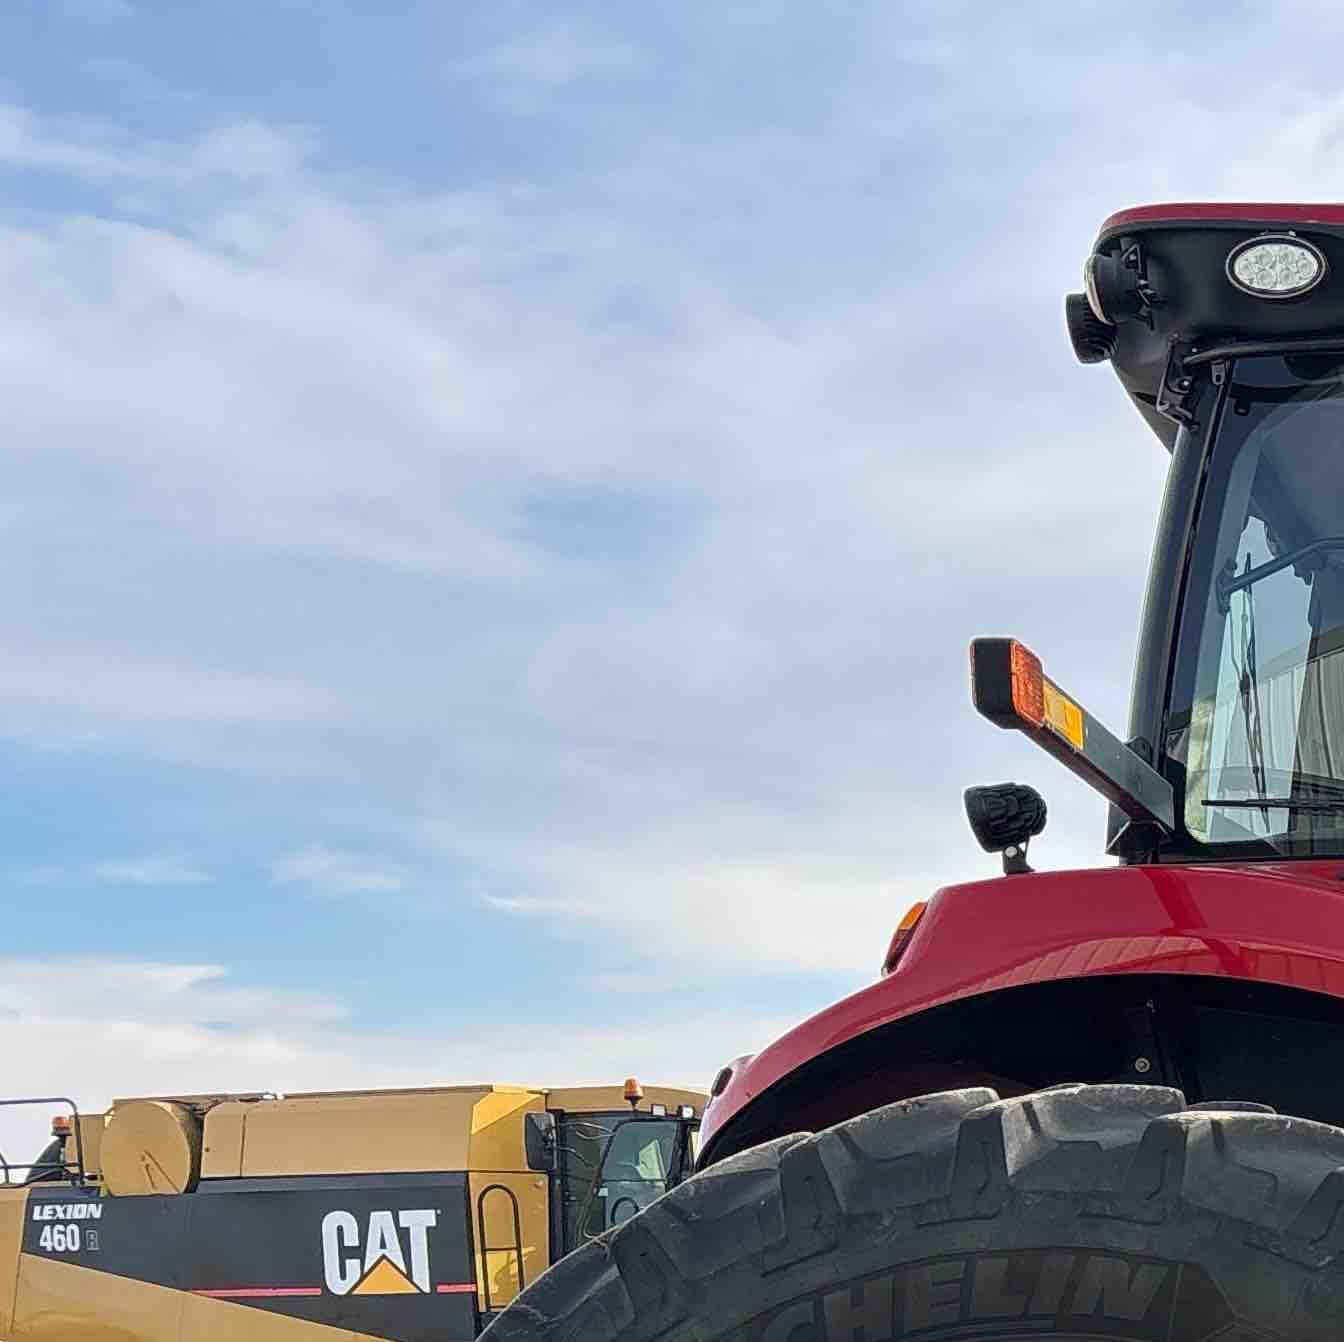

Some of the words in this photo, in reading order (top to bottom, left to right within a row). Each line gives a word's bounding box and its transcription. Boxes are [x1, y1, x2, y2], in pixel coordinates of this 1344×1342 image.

[32, 1203, 103, 1221] LEXION
[39, 1222, 80, 1252] 460
[321, 1208, 437, 1296] CAT
